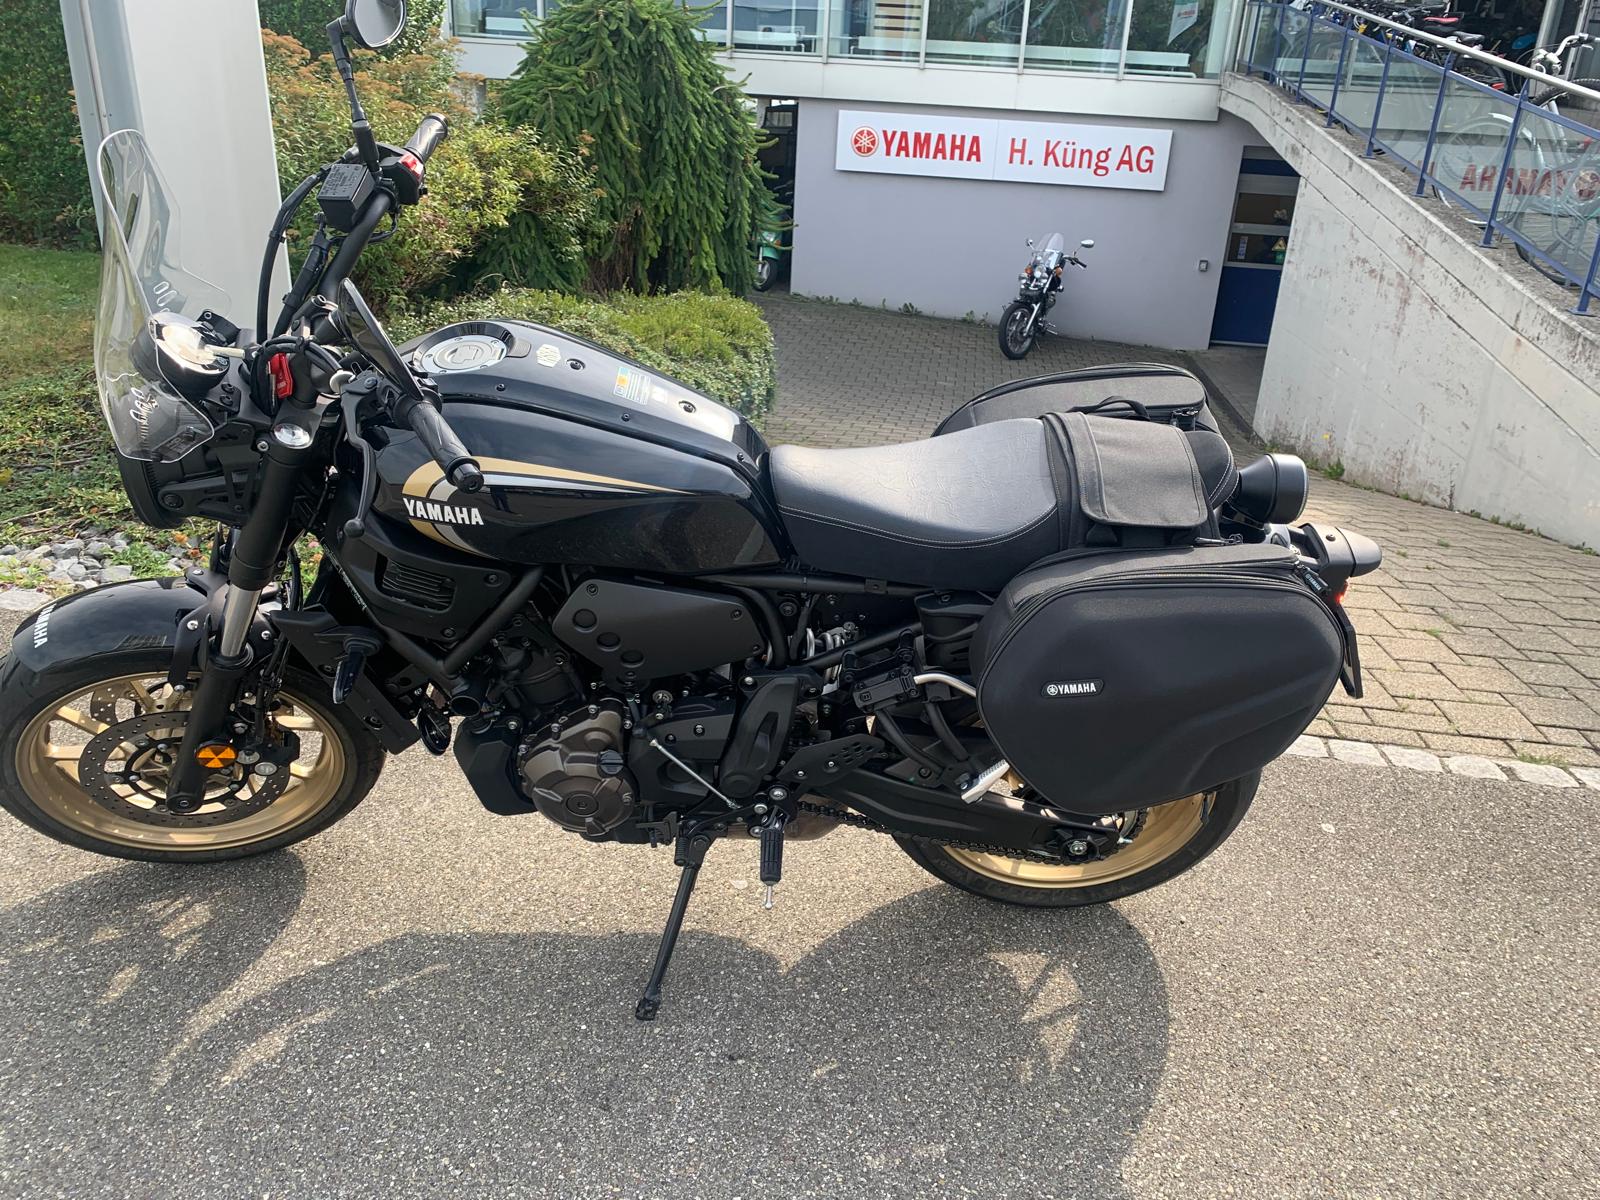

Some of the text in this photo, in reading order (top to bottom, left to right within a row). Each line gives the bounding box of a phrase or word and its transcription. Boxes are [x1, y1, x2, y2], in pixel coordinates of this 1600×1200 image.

[882, 129, 982, 163] YAMAHA
[1008, 137, 1155, 177] H. Küng AG
[402, 497, 485, 526] YAMAHA
[1057, 682, 1097, 695] YAMAHA
